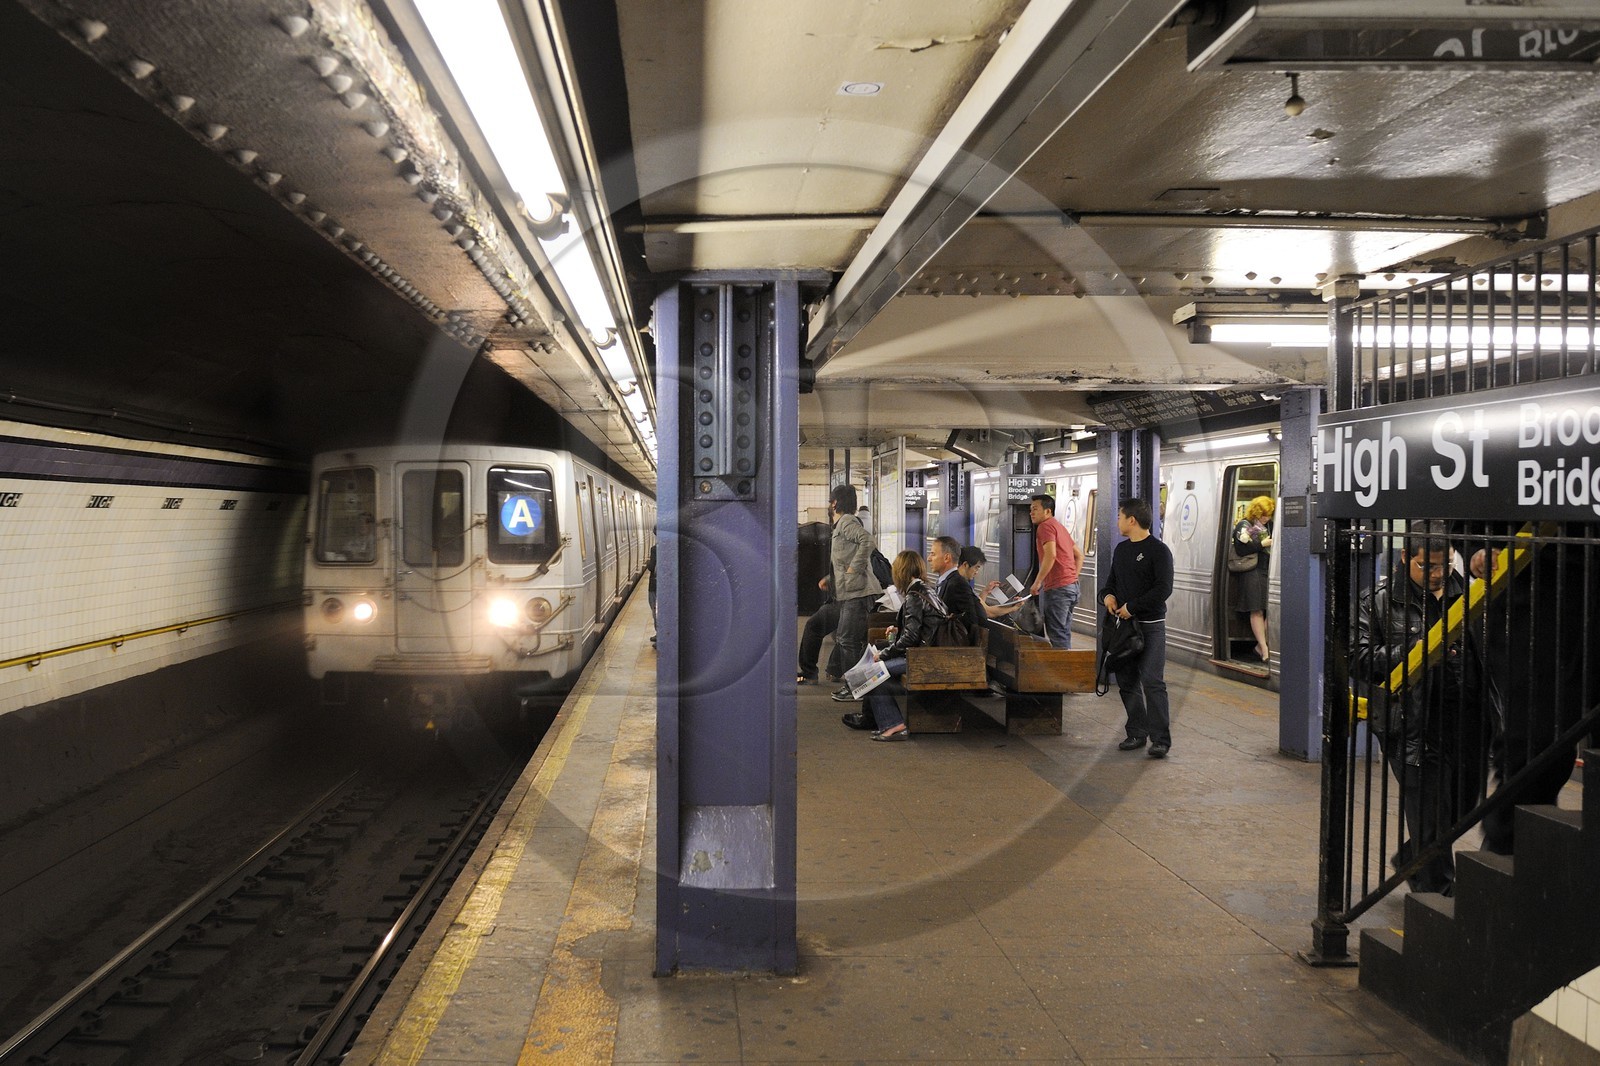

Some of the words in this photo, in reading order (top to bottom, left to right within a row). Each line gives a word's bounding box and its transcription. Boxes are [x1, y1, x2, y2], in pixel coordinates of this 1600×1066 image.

[1317, 421, 1407, 507] High
[1430, 409, 1489, 491] St
[1008, 478, 1028, 488] High
[1031, 478, 1042, 487] St
[87, 496, 113, 508] HIGH
[508, 499, 535, 528] A
